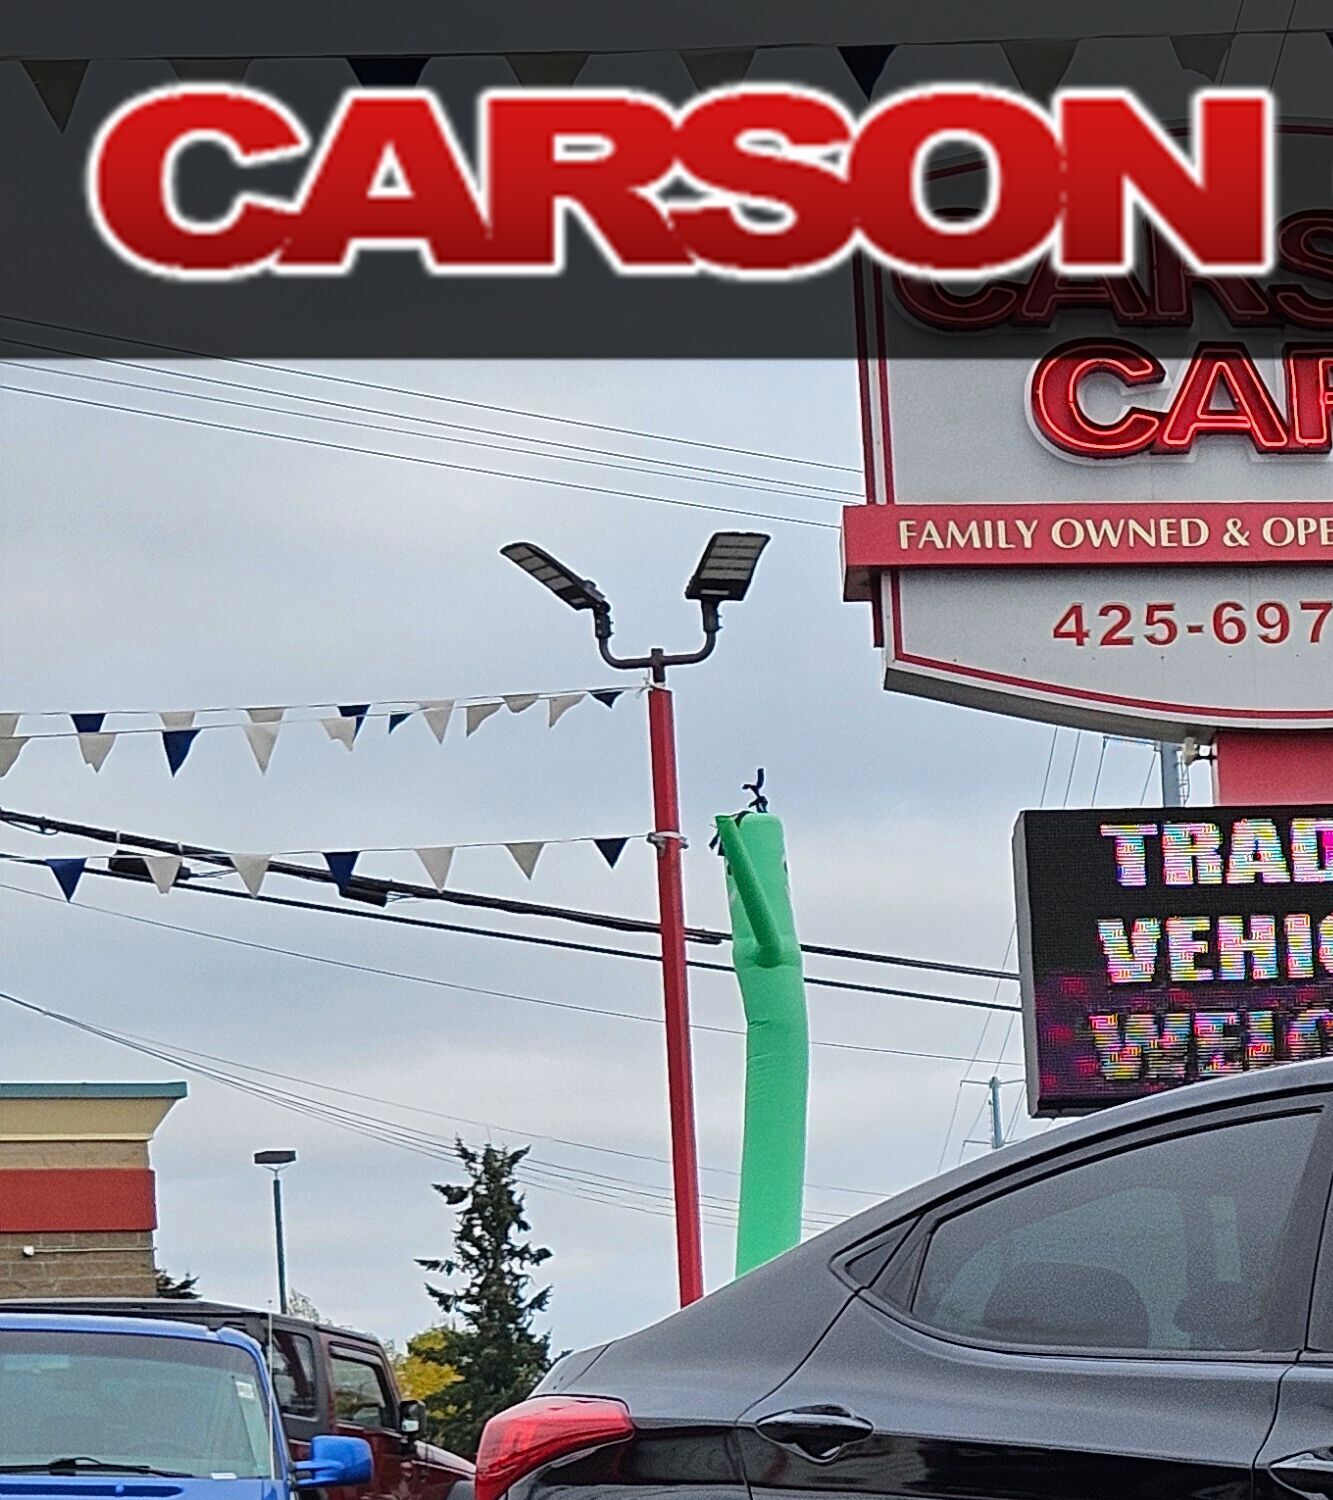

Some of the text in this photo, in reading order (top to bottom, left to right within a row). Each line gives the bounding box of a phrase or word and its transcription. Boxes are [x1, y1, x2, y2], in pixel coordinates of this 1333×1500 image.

[898, 519, 1038, 549] FAMILY
[1051, 517, 1209, 549] OWNED
[1222, 517, 1250, 547] &
